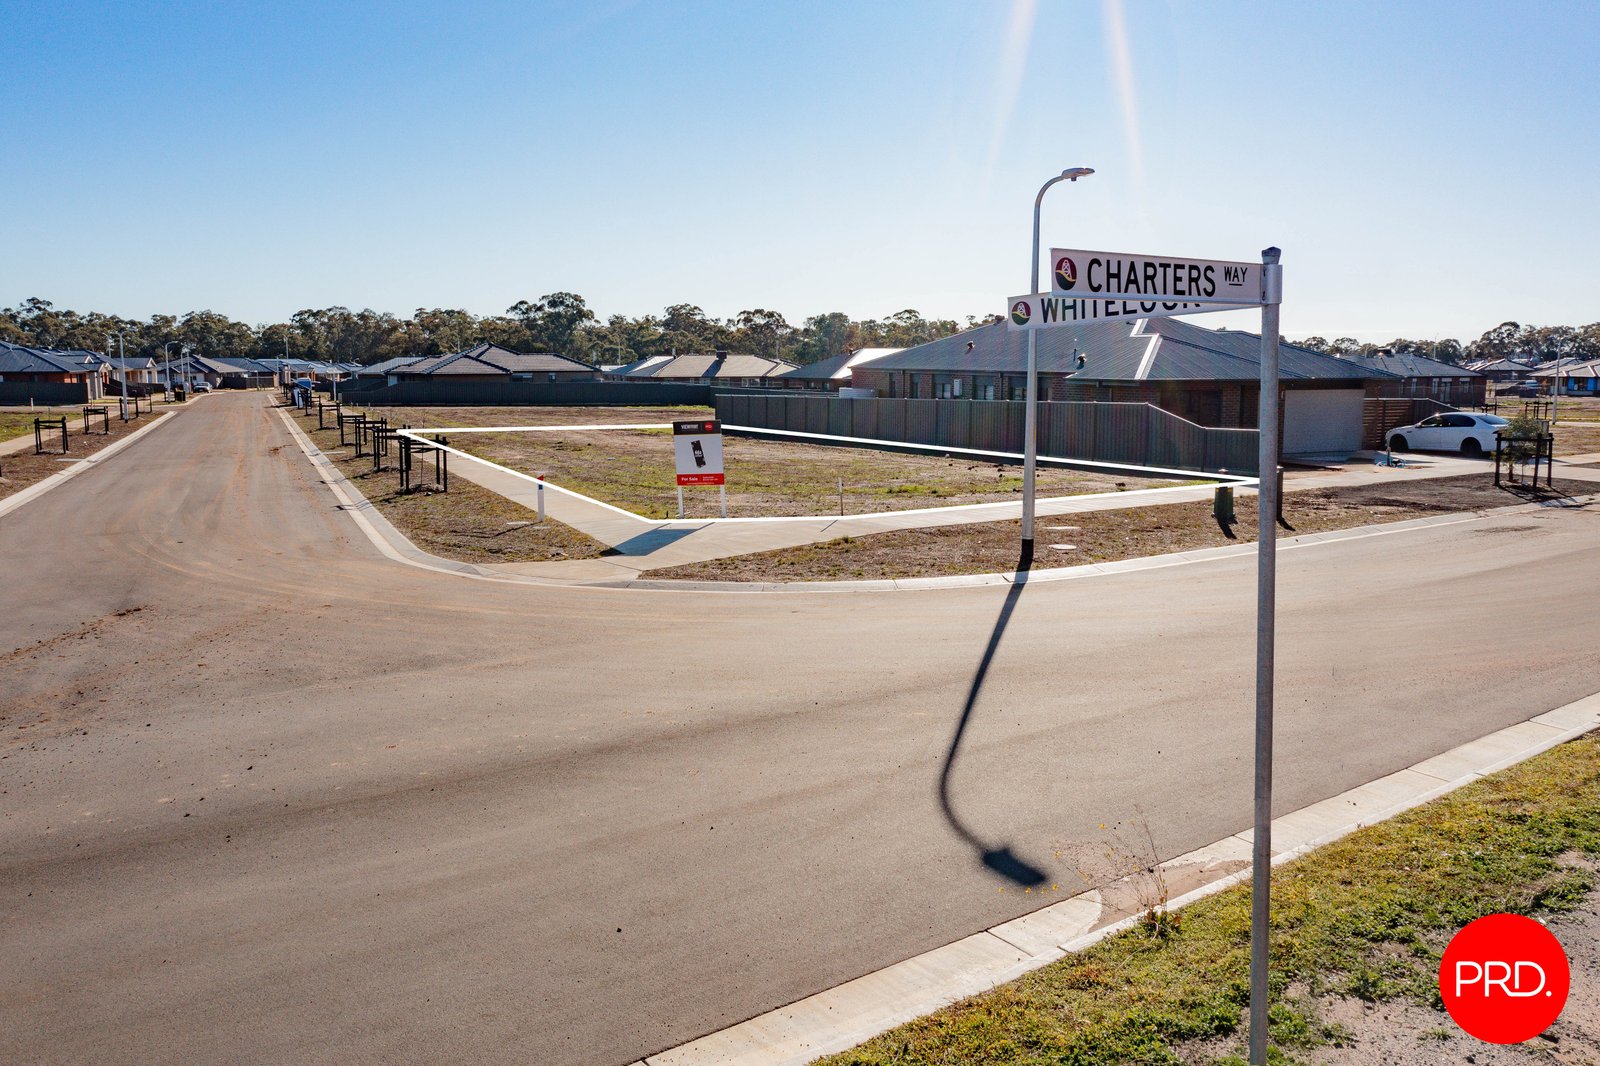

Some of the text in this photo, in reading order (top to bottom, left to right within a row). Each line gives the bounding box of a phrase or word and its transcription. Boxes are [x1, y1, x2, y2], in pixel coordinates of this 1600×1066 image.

[1087, 257, 1248, 297] CHARTERS WAY
[1040, 297, 1201, 324] WHITEL
